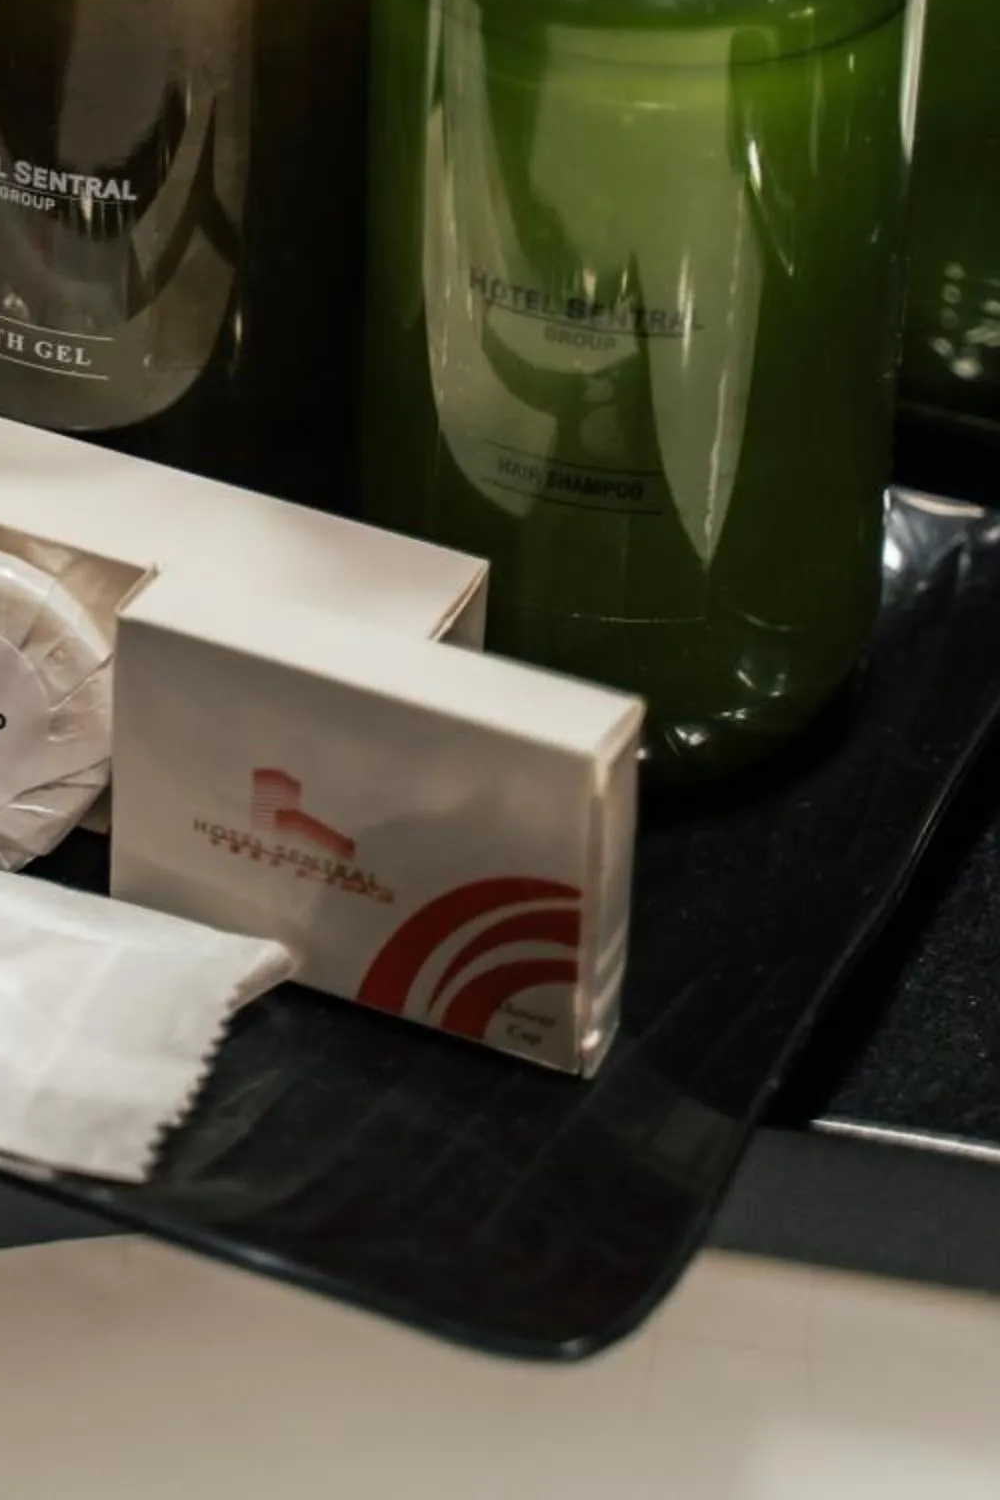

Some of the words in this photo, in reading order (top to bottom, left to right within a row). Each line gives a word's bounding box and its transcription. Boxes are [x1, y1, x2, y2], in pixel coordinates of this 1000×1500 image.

[13, 159, 137, 201] SENTRAL
[0, 185, 56, 212] GROUP
[469, 266, 556, 316] HOTEL
[543, 325, 617, 351] GROUP
[34, 340, 92, 367] GEL
